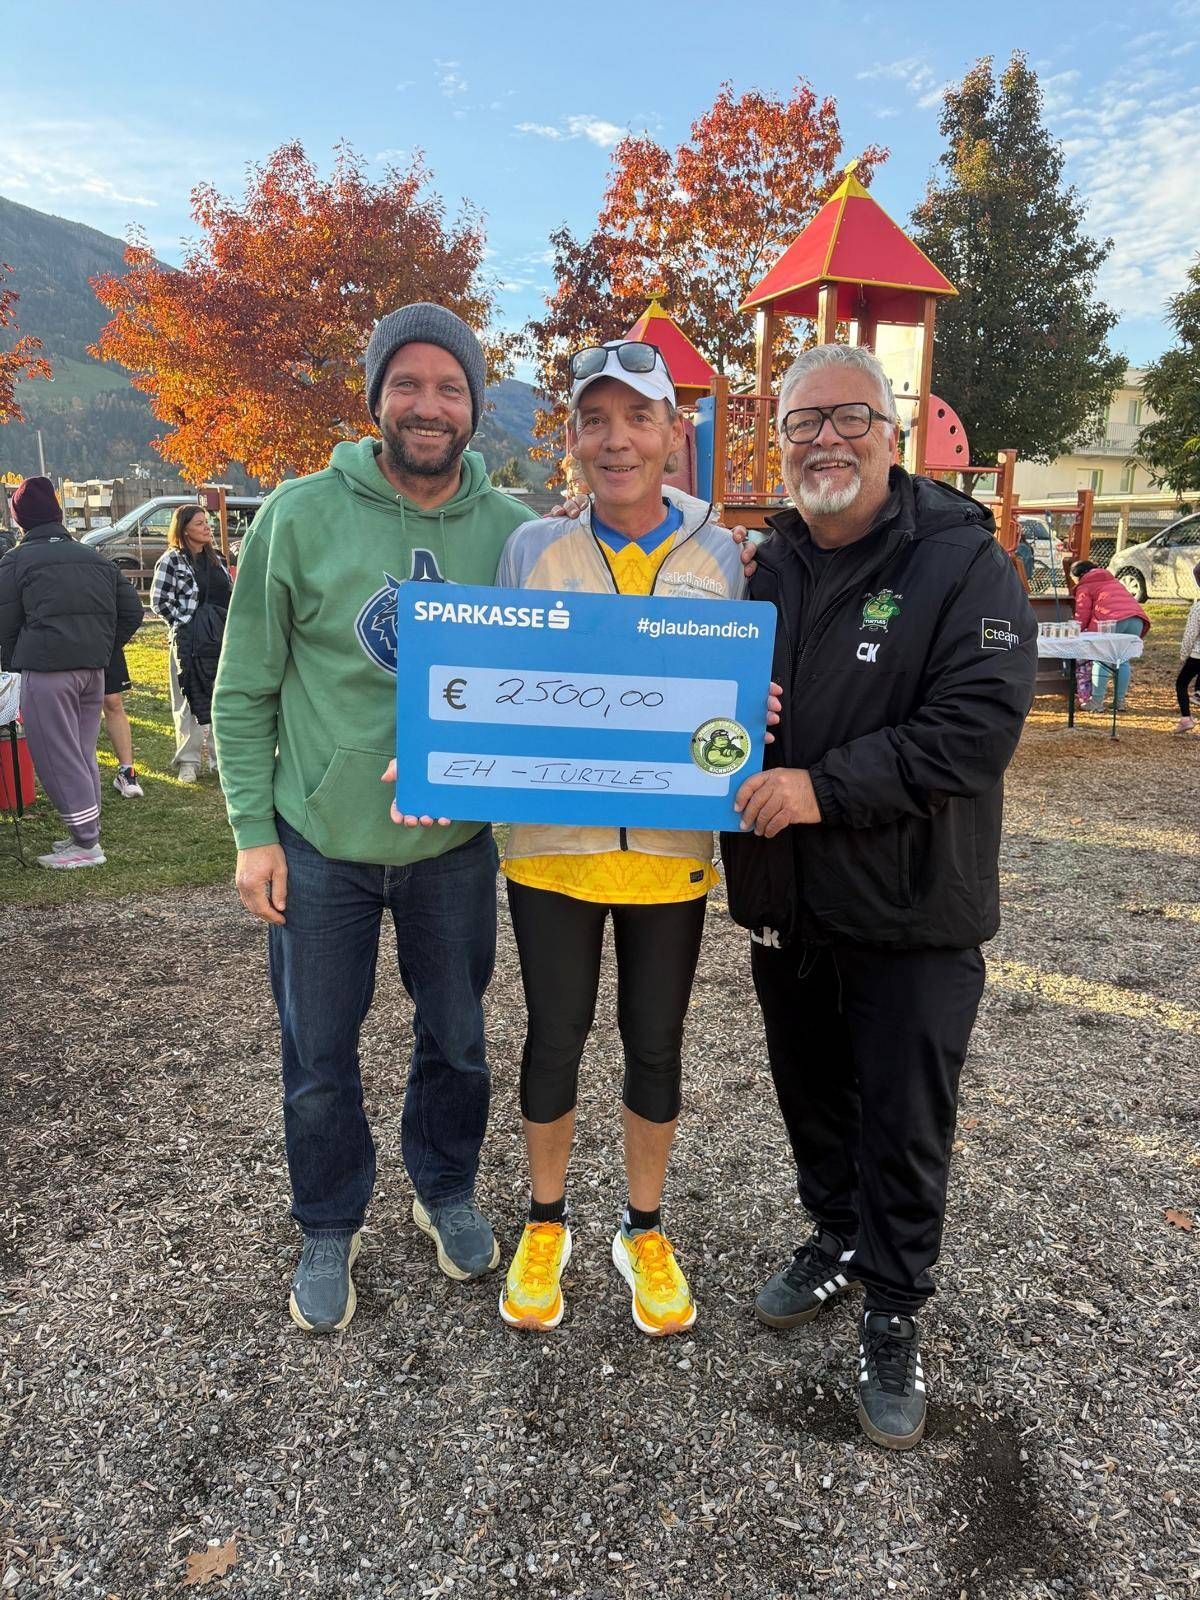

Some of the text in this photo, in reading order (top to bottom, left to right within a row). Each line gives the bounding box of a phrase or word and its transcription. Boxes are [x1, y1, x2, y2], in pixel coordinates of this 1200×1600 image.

[414, 600, 544, 628] SPARKASSE
[636, 617, 760, 638] #glaubandich
[984, 628, 1019, 644] Cteam
[856, 642, 880, 663] CK
[442, 678, 664, 718] € 2500,00
[443, 760, 496, 778] EH
[533, 763, 674, 787] TURTLES
